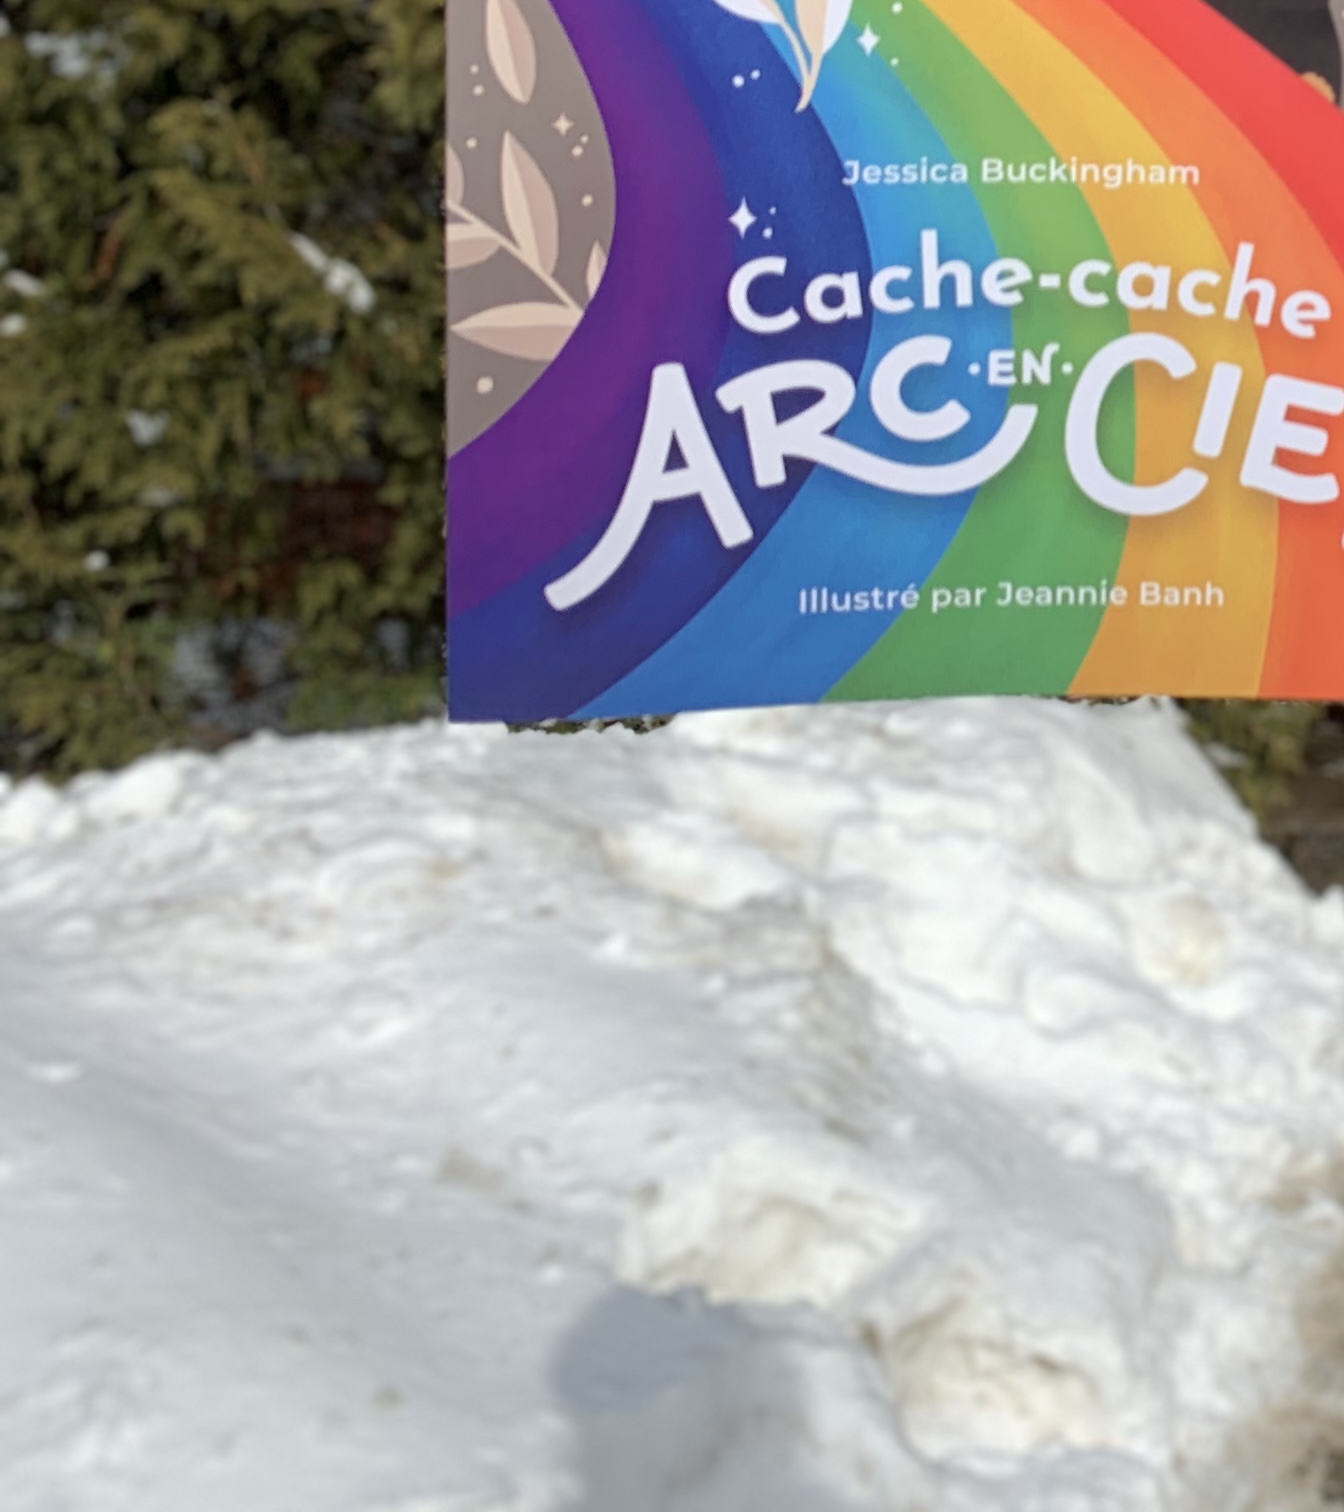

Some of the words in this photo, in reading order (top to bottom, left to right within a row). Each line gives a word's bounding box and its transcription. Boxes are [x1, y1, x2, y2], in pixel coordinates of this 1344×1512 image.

[841, 156, 968, 187] Jessica
[980, 157, 1201, 189] Buckingham
[727, 228, 1332, 339] Cache-cache
[799, 584, 920, 614] Illustré
[930, 584, 988, 614] par
[996, 578, 1128, 607] Jeannie
[1139, 580, 1225, 607] Banh
